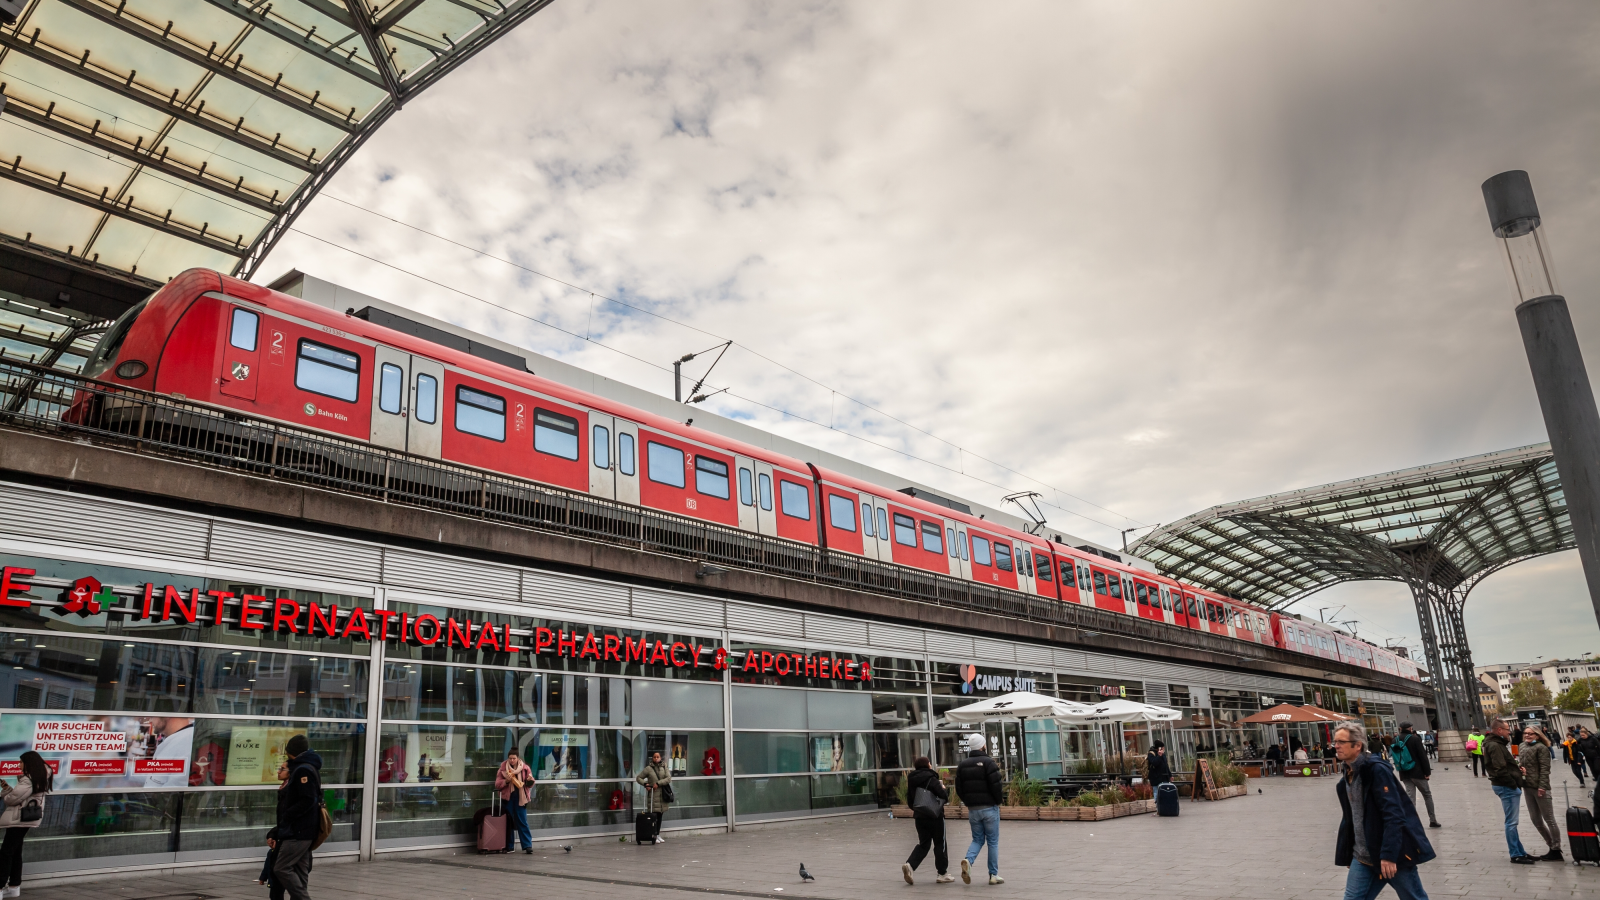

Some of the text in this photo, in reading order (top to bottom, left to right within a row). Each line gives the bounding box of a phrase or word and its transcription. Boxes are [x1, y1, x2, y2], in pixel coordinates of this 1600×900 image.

[272, 332, 283, 348] 2
[318, 408, 333, 418] Bahn
[334, 412, 348, 421] Köln
[516, 404, 524, 418] 2
[686, 453, 693, 466] 2
[686, 498, 697, 510] DB
[142, 582, 520, 653] INTERNATIONAL
[536, 626, 703, 668] PHARMACY
[744, 650, 854, 680] APOTHEKE
[976, 674, 1036, 692] CAMPUS SUITE
[37, 732, 124, 740] UNTERSTÜTZUNG
[35, 742, 56, 750] FÜR
